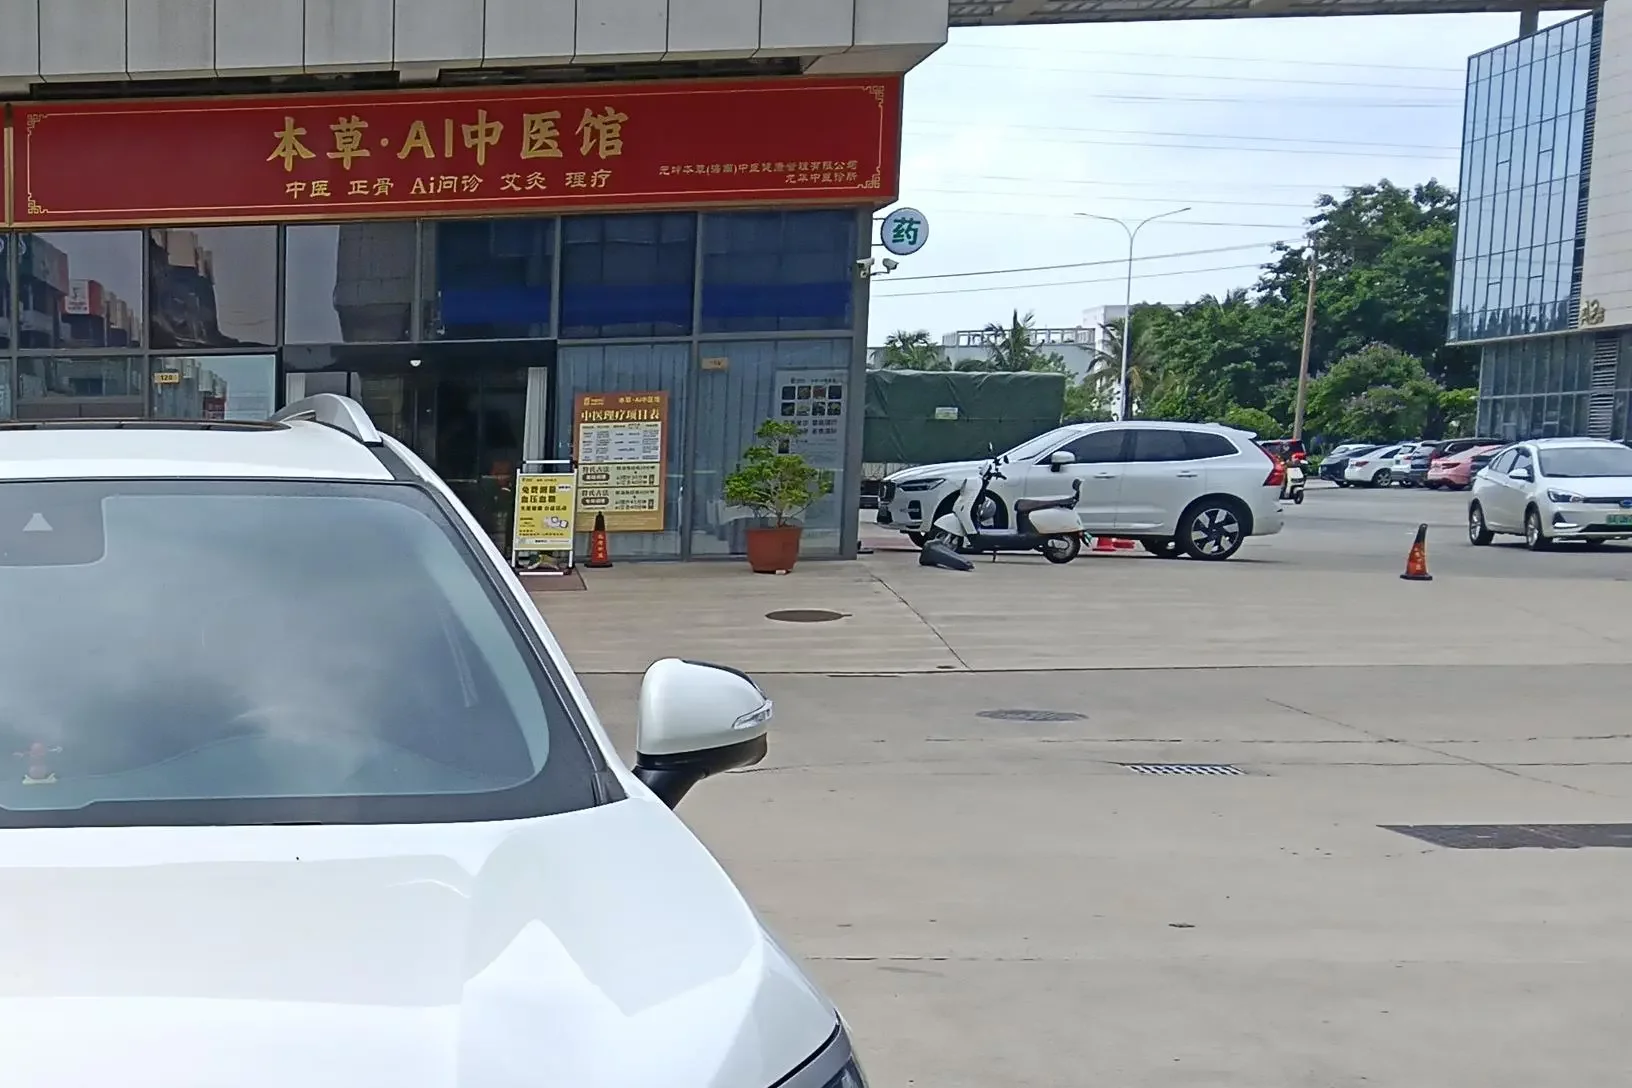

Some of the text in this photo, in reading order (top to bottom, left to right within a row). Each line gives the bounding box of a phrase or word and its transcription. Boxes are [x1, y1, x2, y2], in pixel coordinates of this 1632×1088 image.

[266, 106, 630, 172] 本草·AI中医馆
[285, 168, 613, 199] 中医 正骨 Ai问诊 艾灸 理疗
[891, 217, 922, 246] 药
